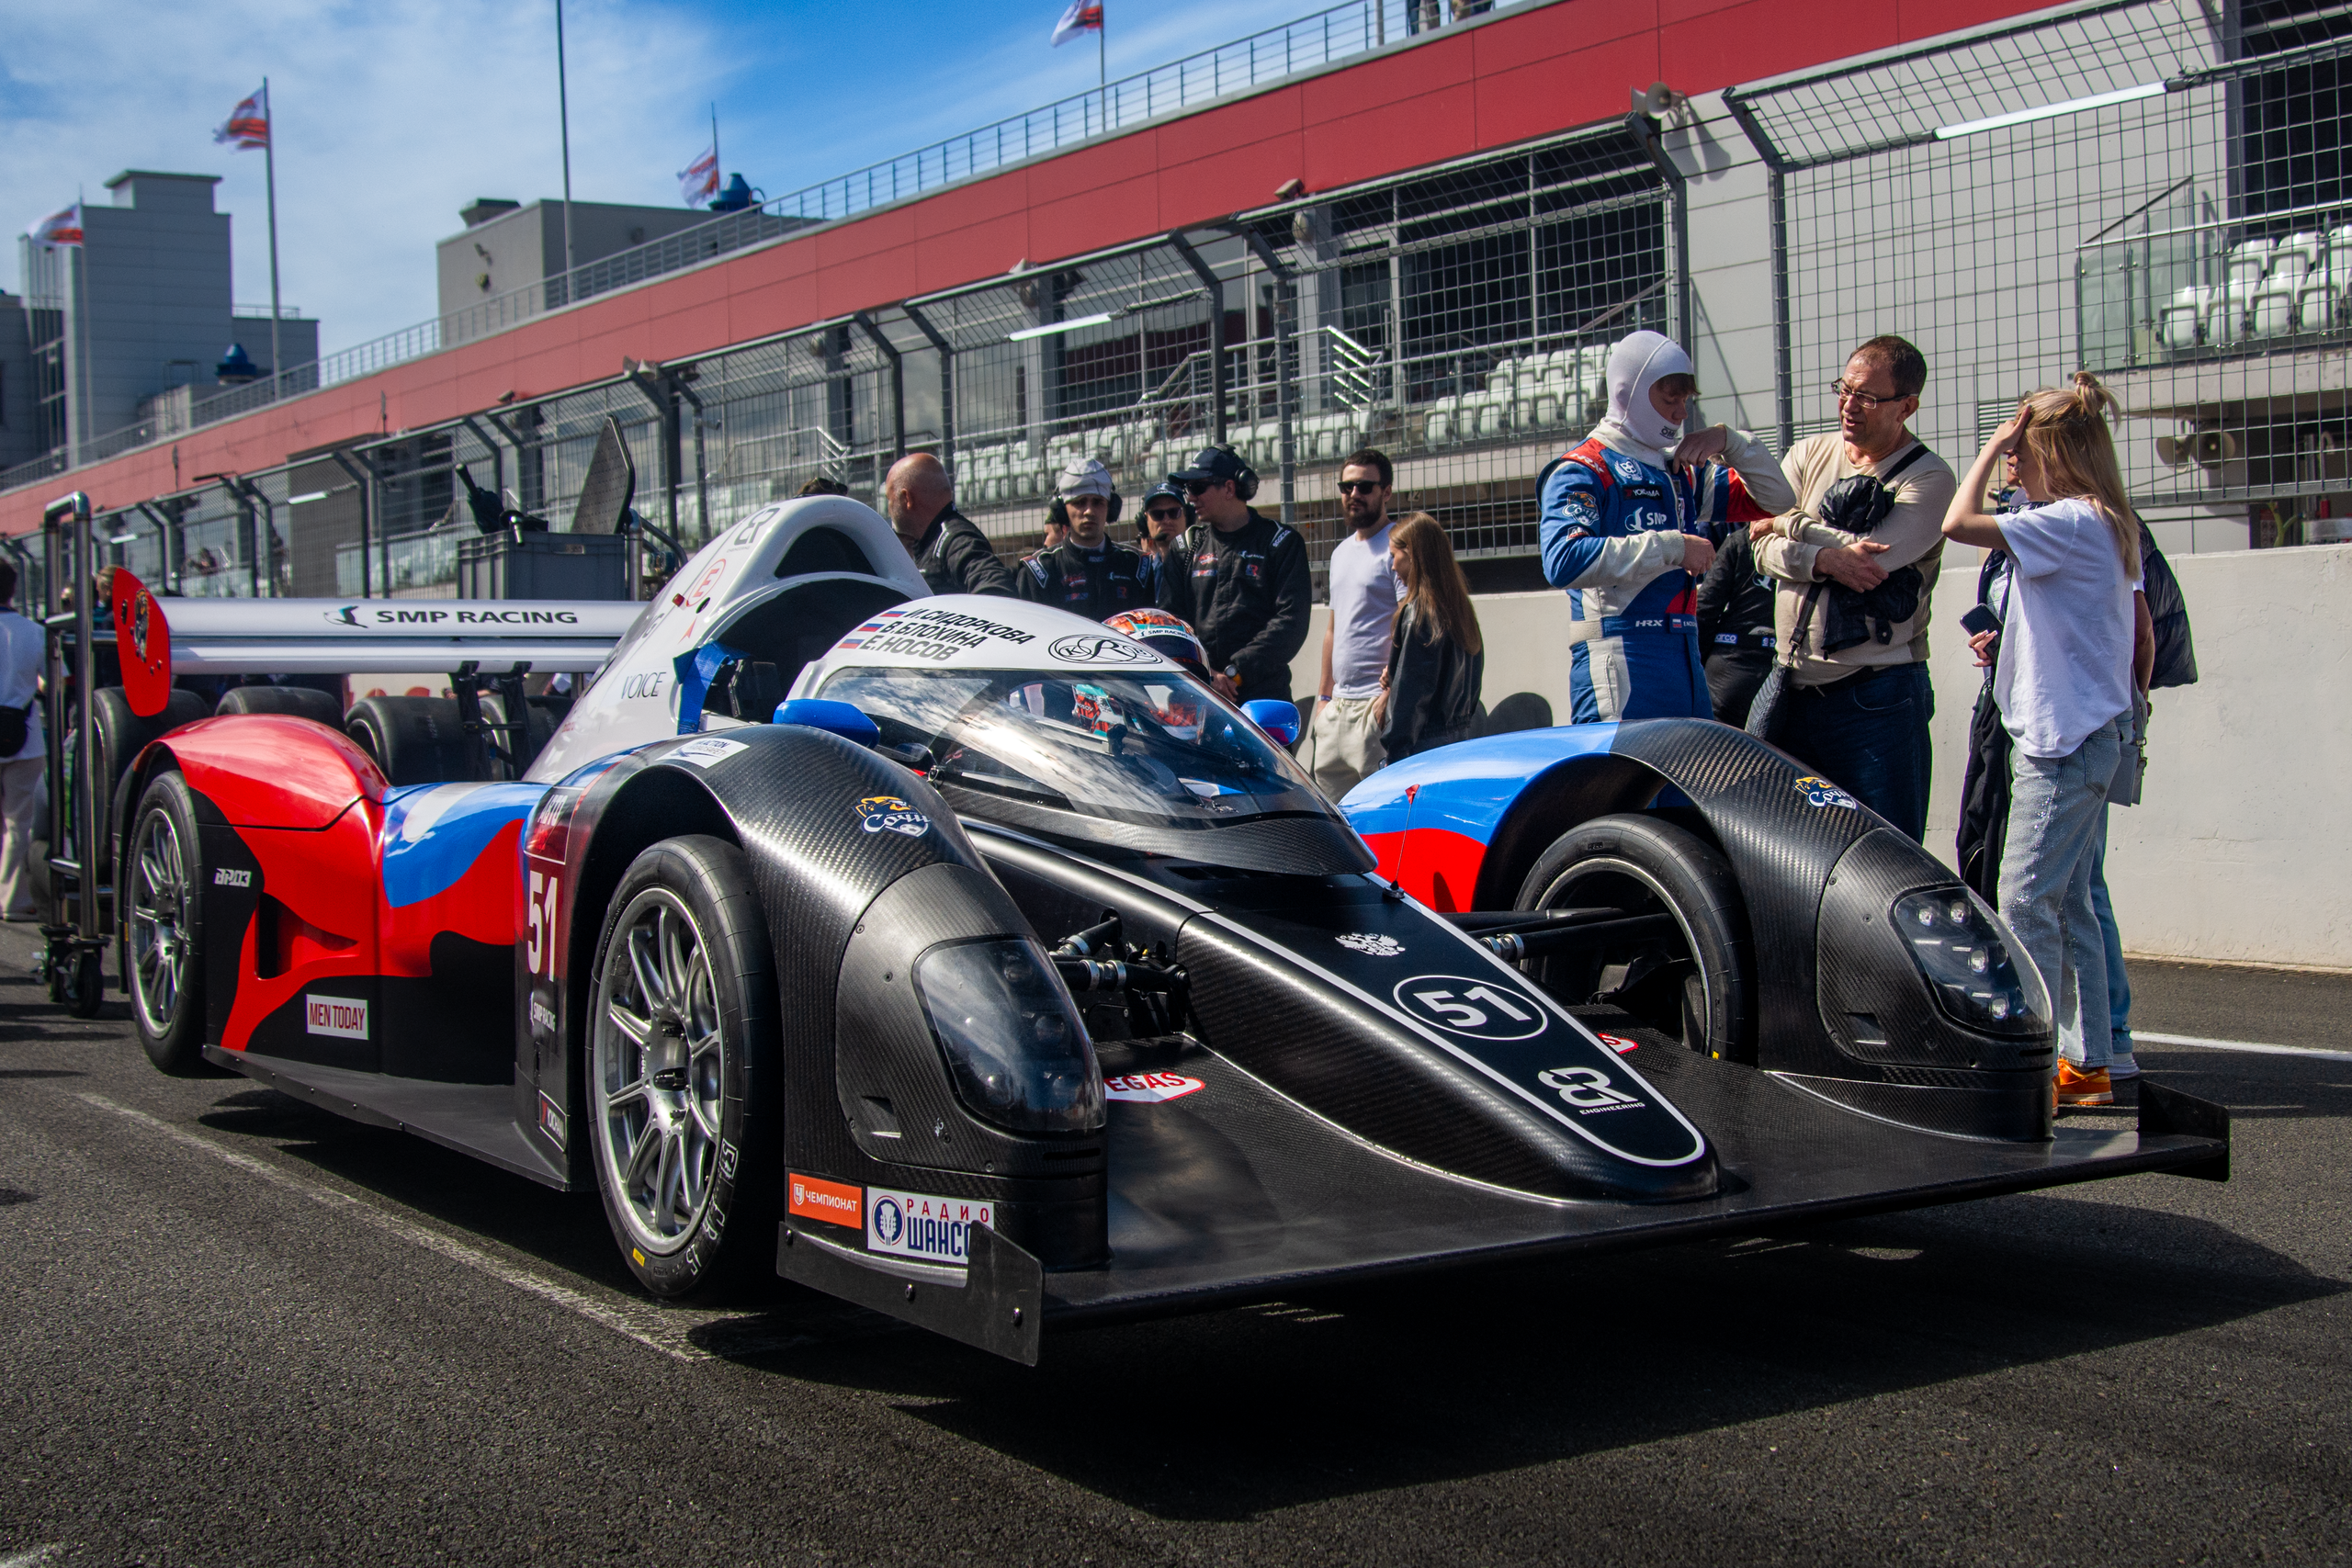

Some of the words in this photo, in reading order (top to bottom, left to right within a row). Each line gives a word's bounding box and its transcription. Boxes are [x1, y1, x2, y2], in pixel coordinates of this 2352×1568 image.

[377, 611, 448, 623] SMP
[457, 611, 578, 624] RACING
[904, 608, 1036, 645] И.СИДОРКОВА
[1635, 619, 1664, 627] HRX
[859, 635, 961, 660] Е.НОСОВ
[880, 621, 989, 649] В.БЛОХИНА
[621, 671, 666, 699] VOICE
[527, 870, 558, 983] 51
[309, 1002, 331, 1028] MEN
[333, 1005, 366, 1032] TODAY
[1412, 986, 1532, 1027] 51
[1103, 1071, 1186, 1093] EGAS
[1579, 1101, 1645, 1115] ENGINEERING
[805, 1190, 857, 1212] ЧЕМПИОНАТ
[907, 1198, 989, 1223] РАДИО
[907, 1216, 971, 1258] ШАНС
